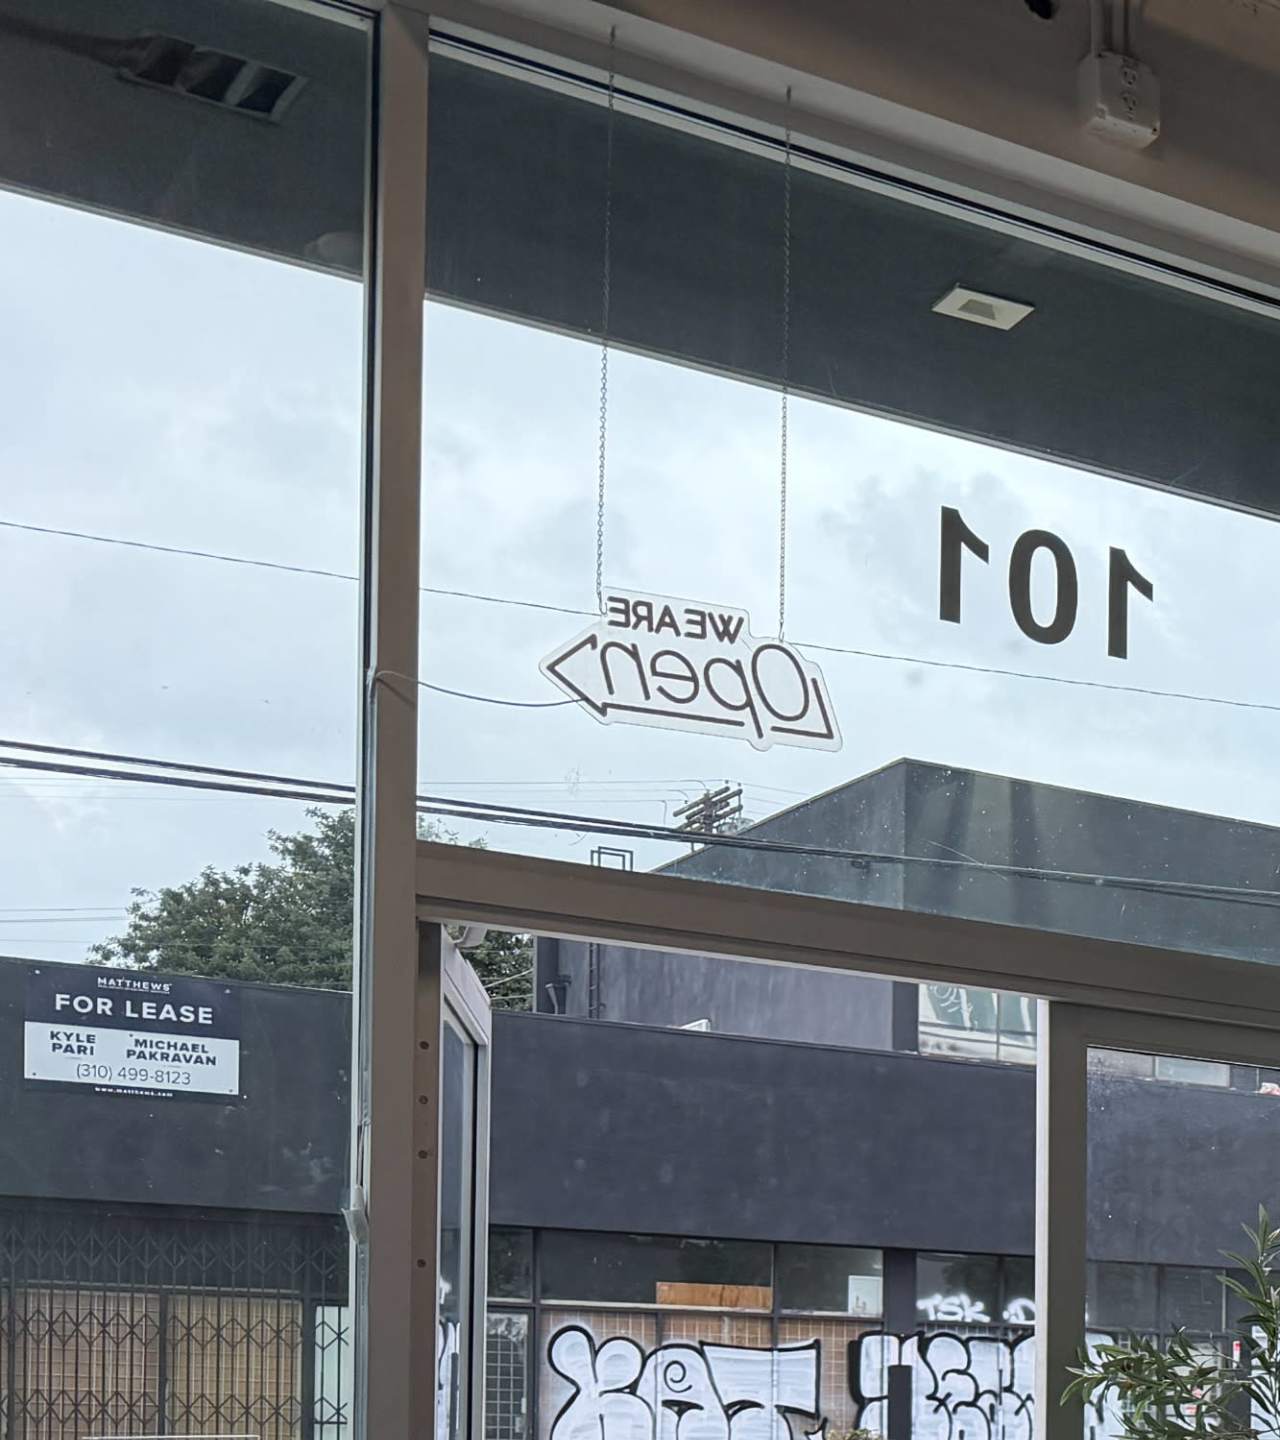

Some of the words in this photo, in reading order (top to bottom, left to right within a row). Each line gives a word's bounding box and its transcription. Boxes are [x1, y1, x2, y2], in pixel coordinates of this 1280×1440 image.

[97, 976, 171, 992] MATTHEWS
[55, 993, 113, 1016] FOR
[125, 1000, 213, 1025] LEASE
[49, 1030, 96, 1044] KYLE
[51, 1042, 95, 1056] PARI
[133, 1038, 209, 1054] MICHAEL
[126, 1049, 217, 1066] PAKRAVAN
[76, 1063, 113, 1081] (310)
[118, 1067, 191, 1085] 499-8123
